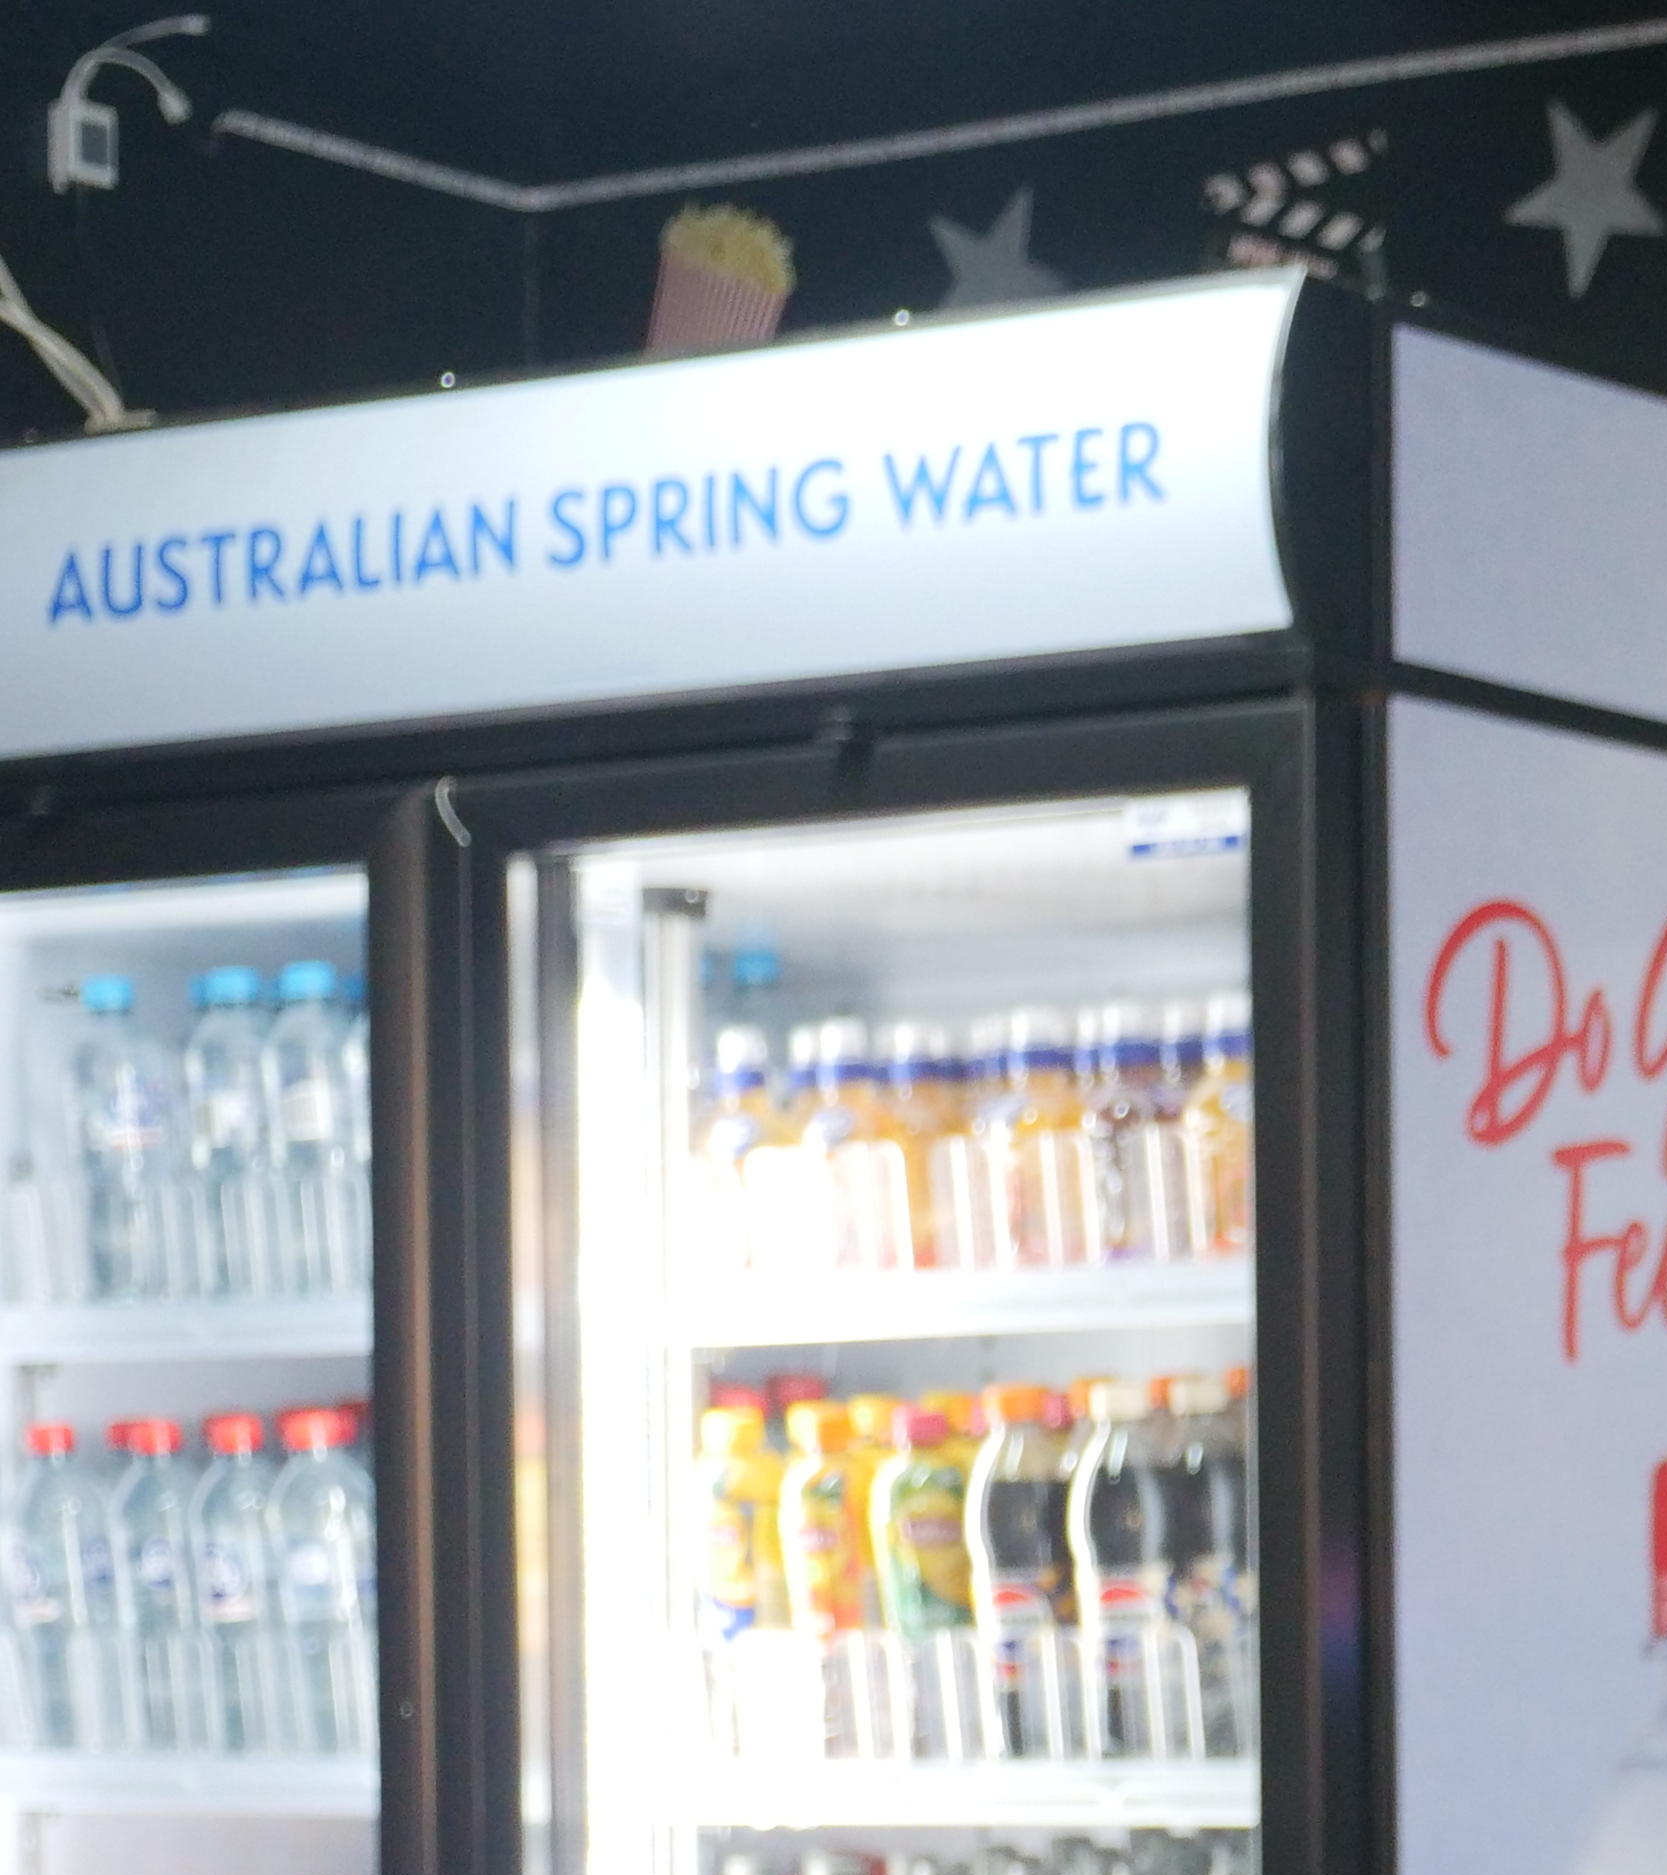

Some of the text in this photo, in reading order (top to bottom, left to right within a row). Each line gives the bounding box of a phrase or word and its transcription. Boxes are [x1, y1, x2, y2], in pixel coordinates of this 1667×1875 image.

[46, 418, 1167, 627] AUSTRALIAN SPRING WATER
[1422, 894, 1613, 1150] Do
